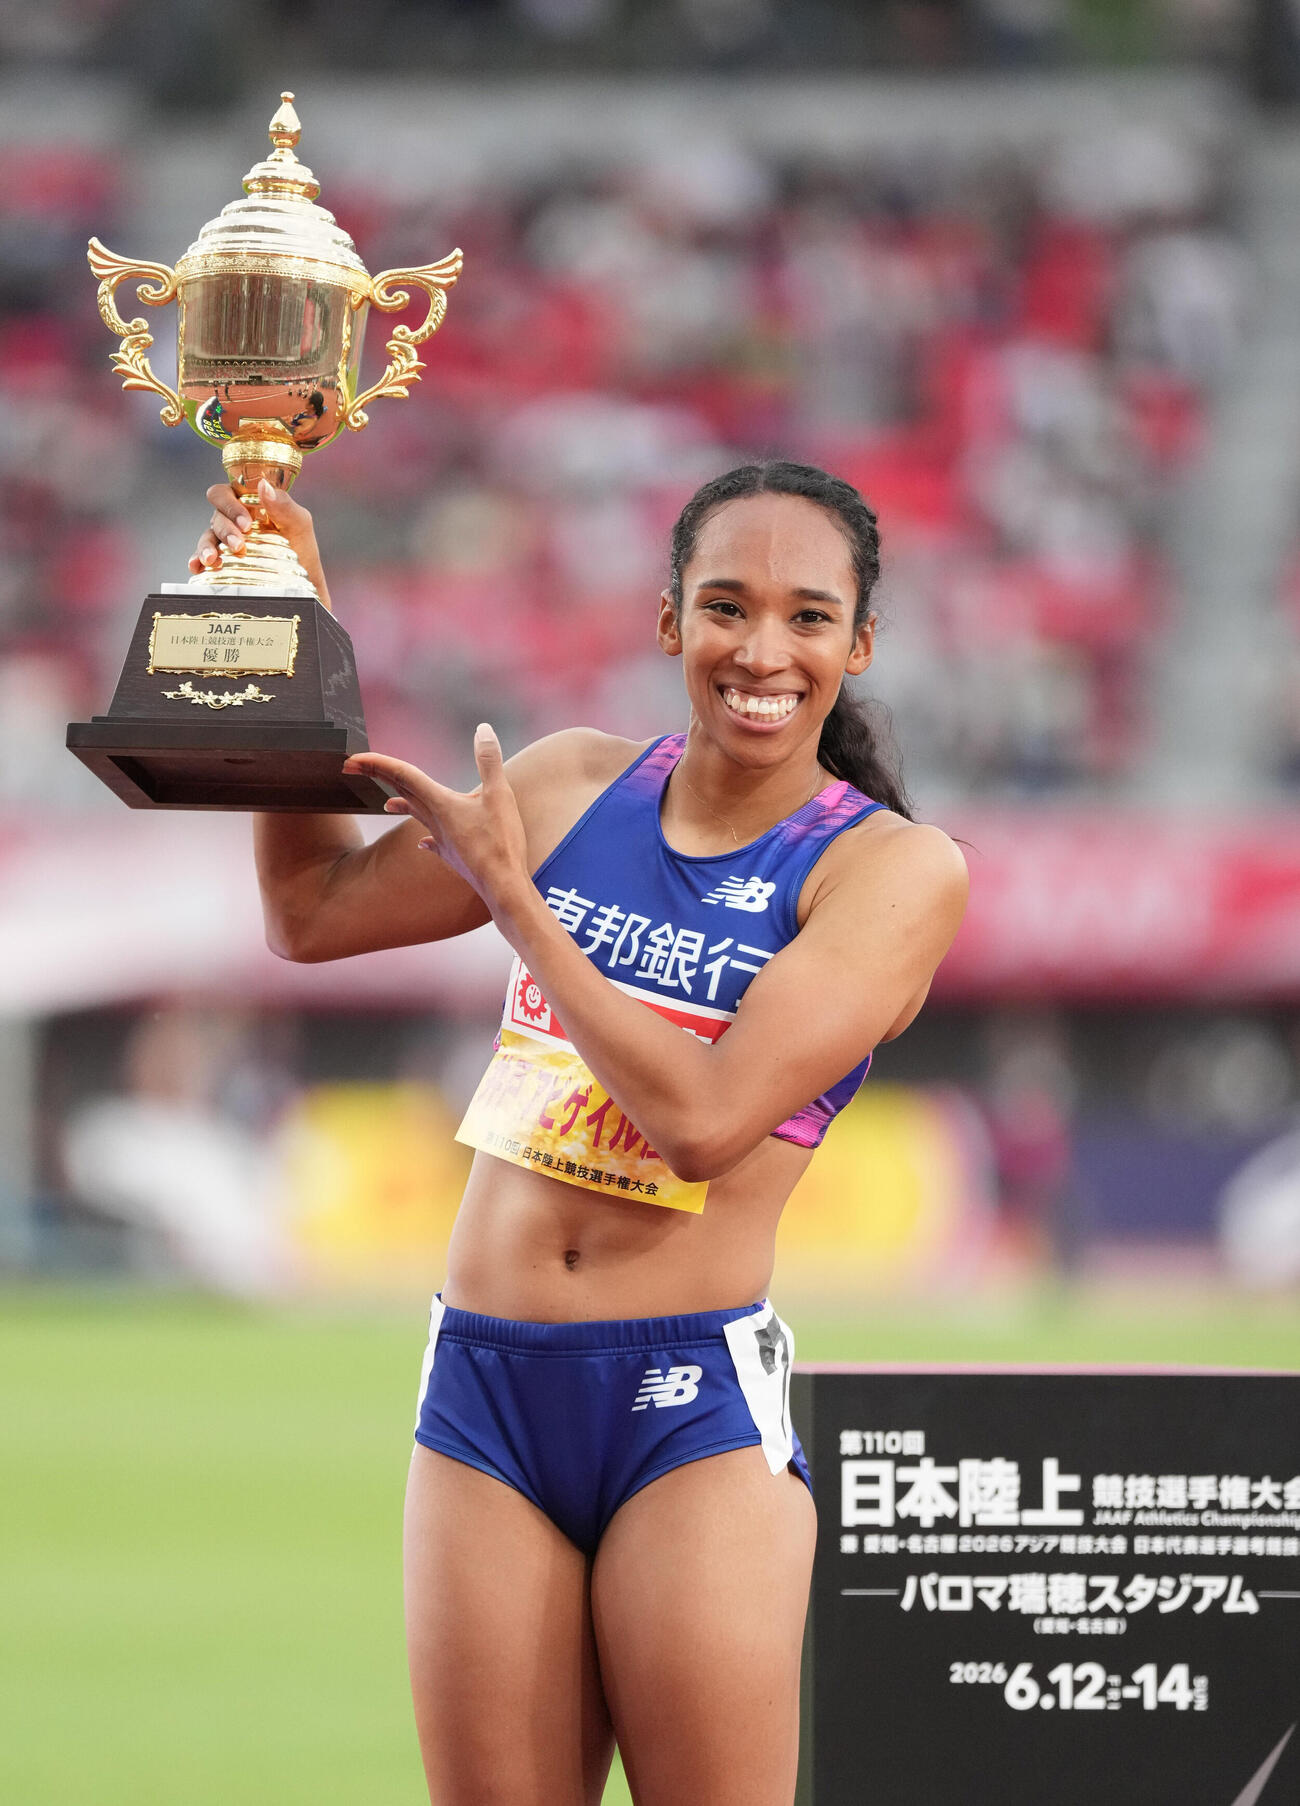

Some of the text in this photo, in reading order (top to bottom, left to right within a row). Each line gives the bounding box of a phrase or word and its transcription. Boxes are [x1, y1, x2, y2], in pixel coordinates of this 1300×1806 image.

[170, 634, 275, 648] 日本陸上競技選手権大会
[207, 623, 241, 635] JAAF
[701, 876, 776, 913] NB
[545, 886, 775, 1007] 東邦銀行
[631, 1365, 703, 1412] NB
[840, 1430, 926, 1455] 第110回
[1092, 1510, 1132, 1526] JAAF
[1134, 1510, 1200, 1527] Athletics
[900, 1573, 1259, 1615] パロマ瑞穂スタジアム
[949, 1662, 1007, 1684] 2026
